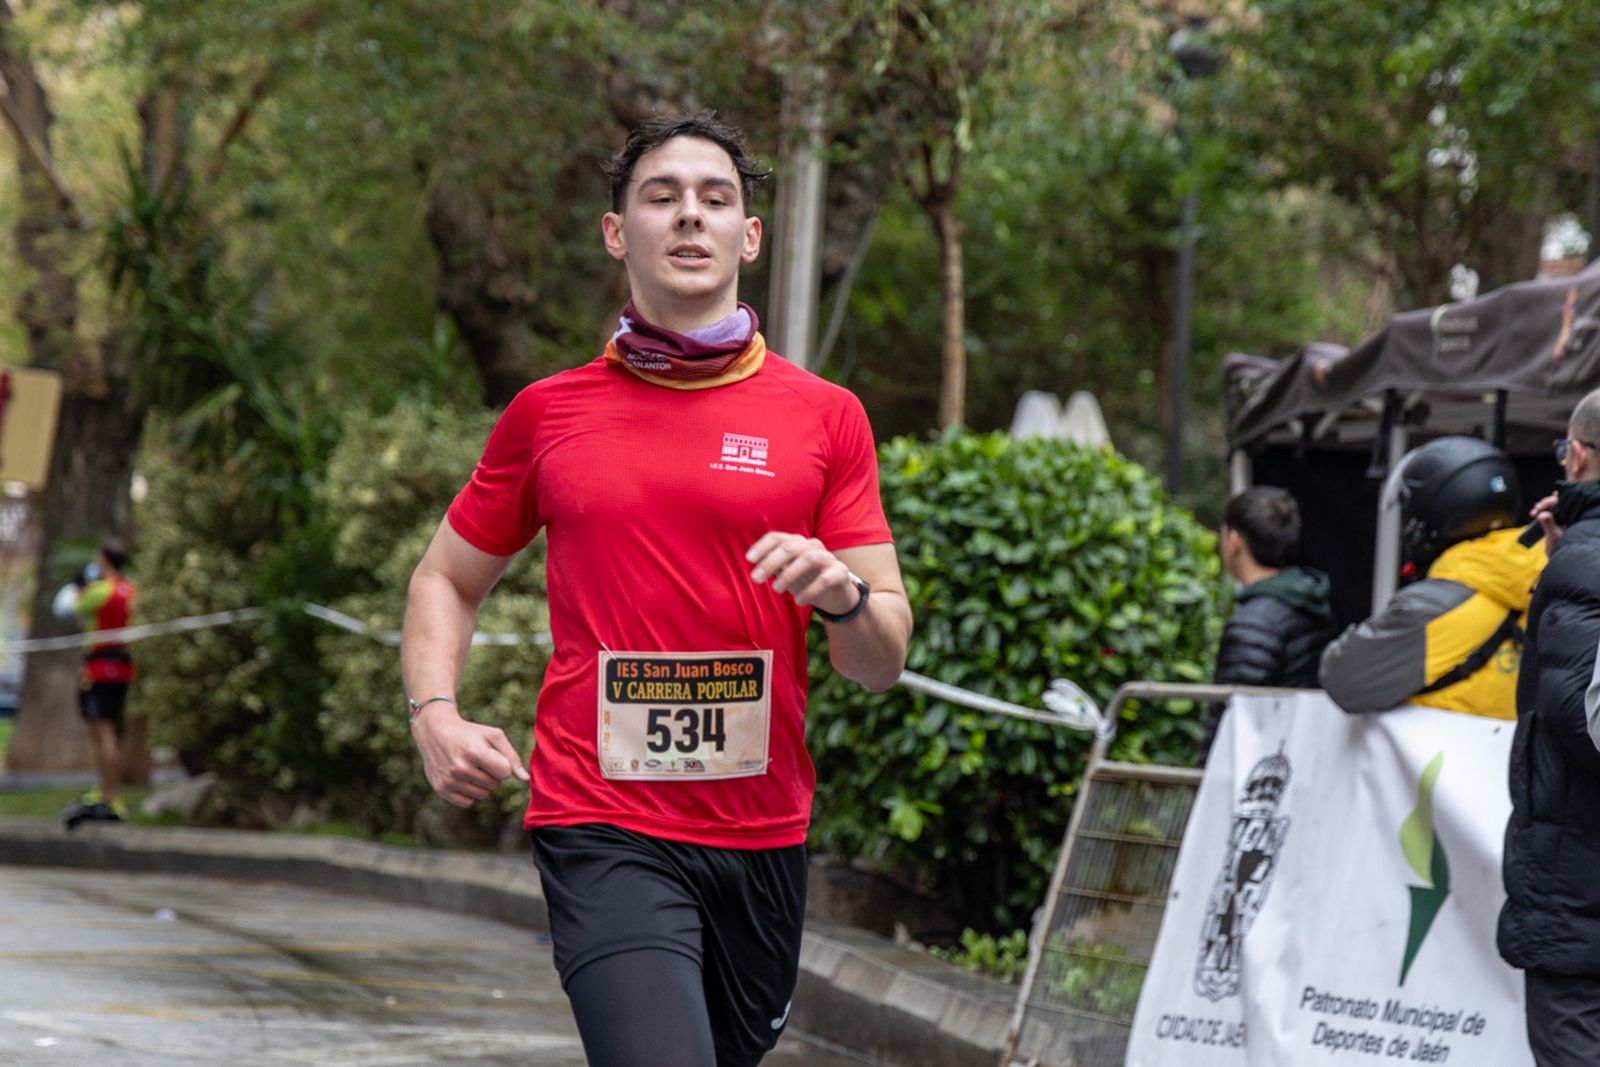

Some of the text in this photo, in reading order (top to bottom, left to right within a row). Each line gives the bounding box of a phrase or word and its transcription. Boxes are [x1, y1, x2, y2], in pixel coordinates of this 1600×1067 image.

[755, 468, 776, 477] Bosco
[617, 661, 754, 678] IES San Juan Bosco
[612, 680, 758, 700] V CARRERA POPULAR
[646, 708, 726, 753] 534
[1299, 986, 1486, 1036] Patronato Municipal de
[1312, 1021, 1450, 1064] Deportes de Jaén
